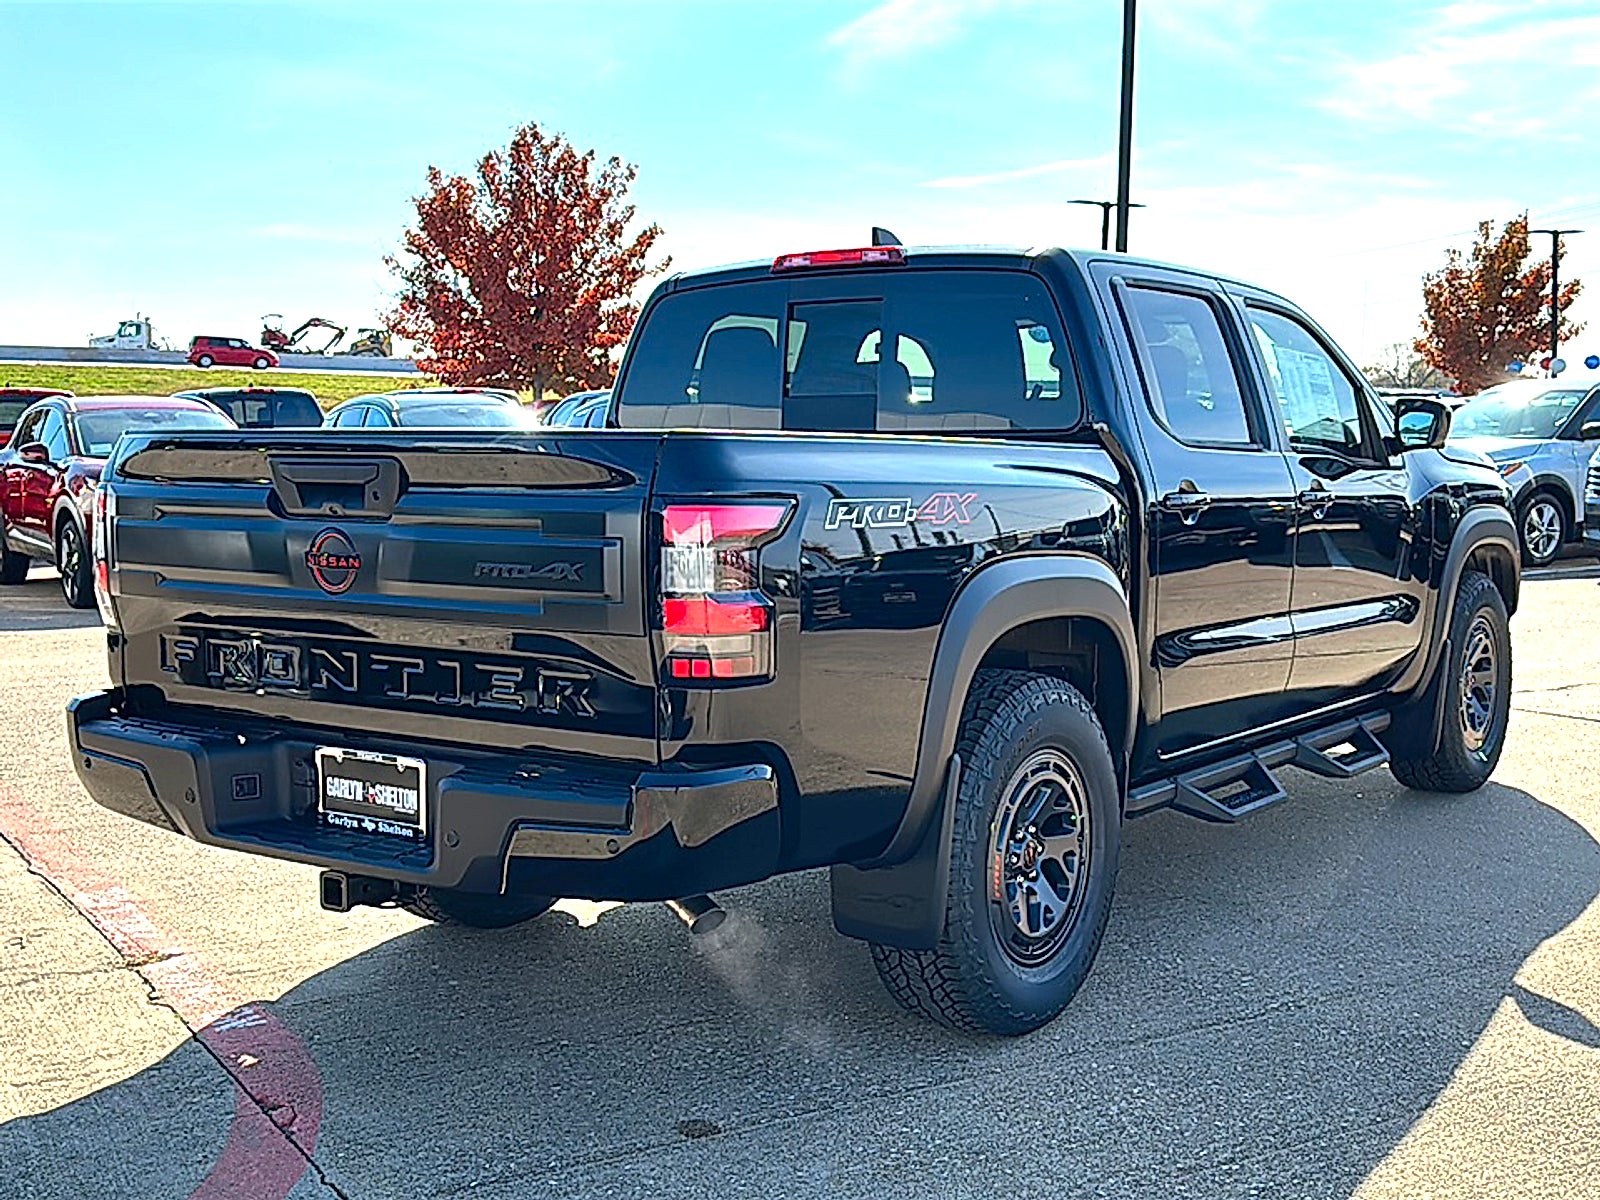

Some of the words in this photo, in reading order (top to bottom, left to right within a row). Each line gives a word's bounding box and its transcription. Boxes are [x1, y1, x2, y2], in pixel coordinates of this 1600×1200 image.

[306, 552, 361, 569] NISSAN
[160, 632, 600, 720] FRONTIER
[326, 776, 363, 802] GARLYN
[374, 783, 418, 812] SHELTON
[377, 821, 414, 838] Shelton
